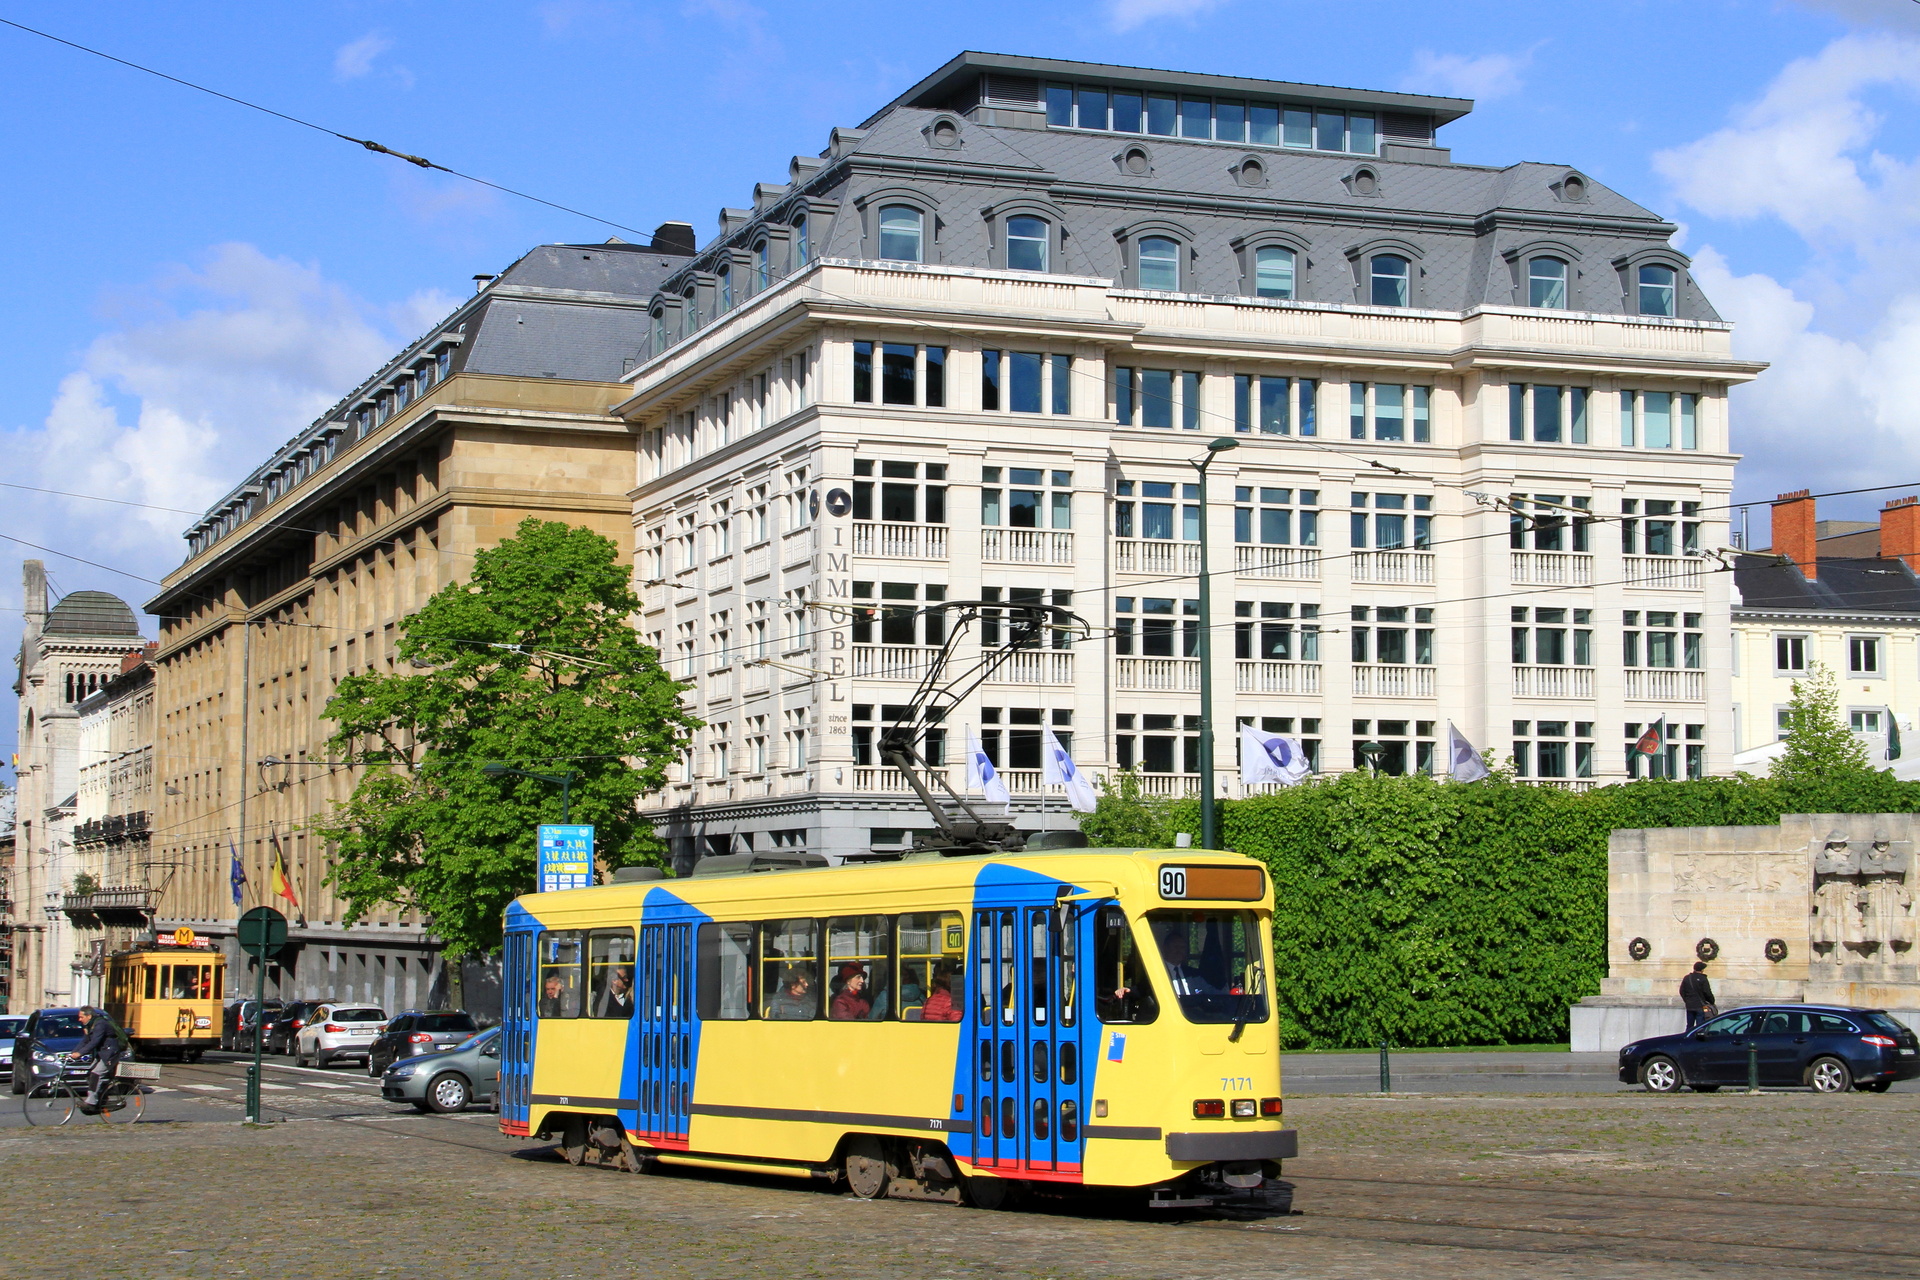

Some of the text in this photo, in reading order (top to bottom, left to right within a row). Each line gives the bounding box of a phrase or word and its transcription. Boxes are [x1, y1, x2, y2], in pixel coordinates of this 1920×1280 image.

[827, 526, 849, 702] IMMOBEL
[828, 713, 848, 723] since
[829, 725, 847, 735] 1863
[1162, 871, 1185, 895] 90
[178, 929, 190, 942] M
[1220, 1077, 1252, 1091] 7171
[929, 1119, 943, 1129] 7171
